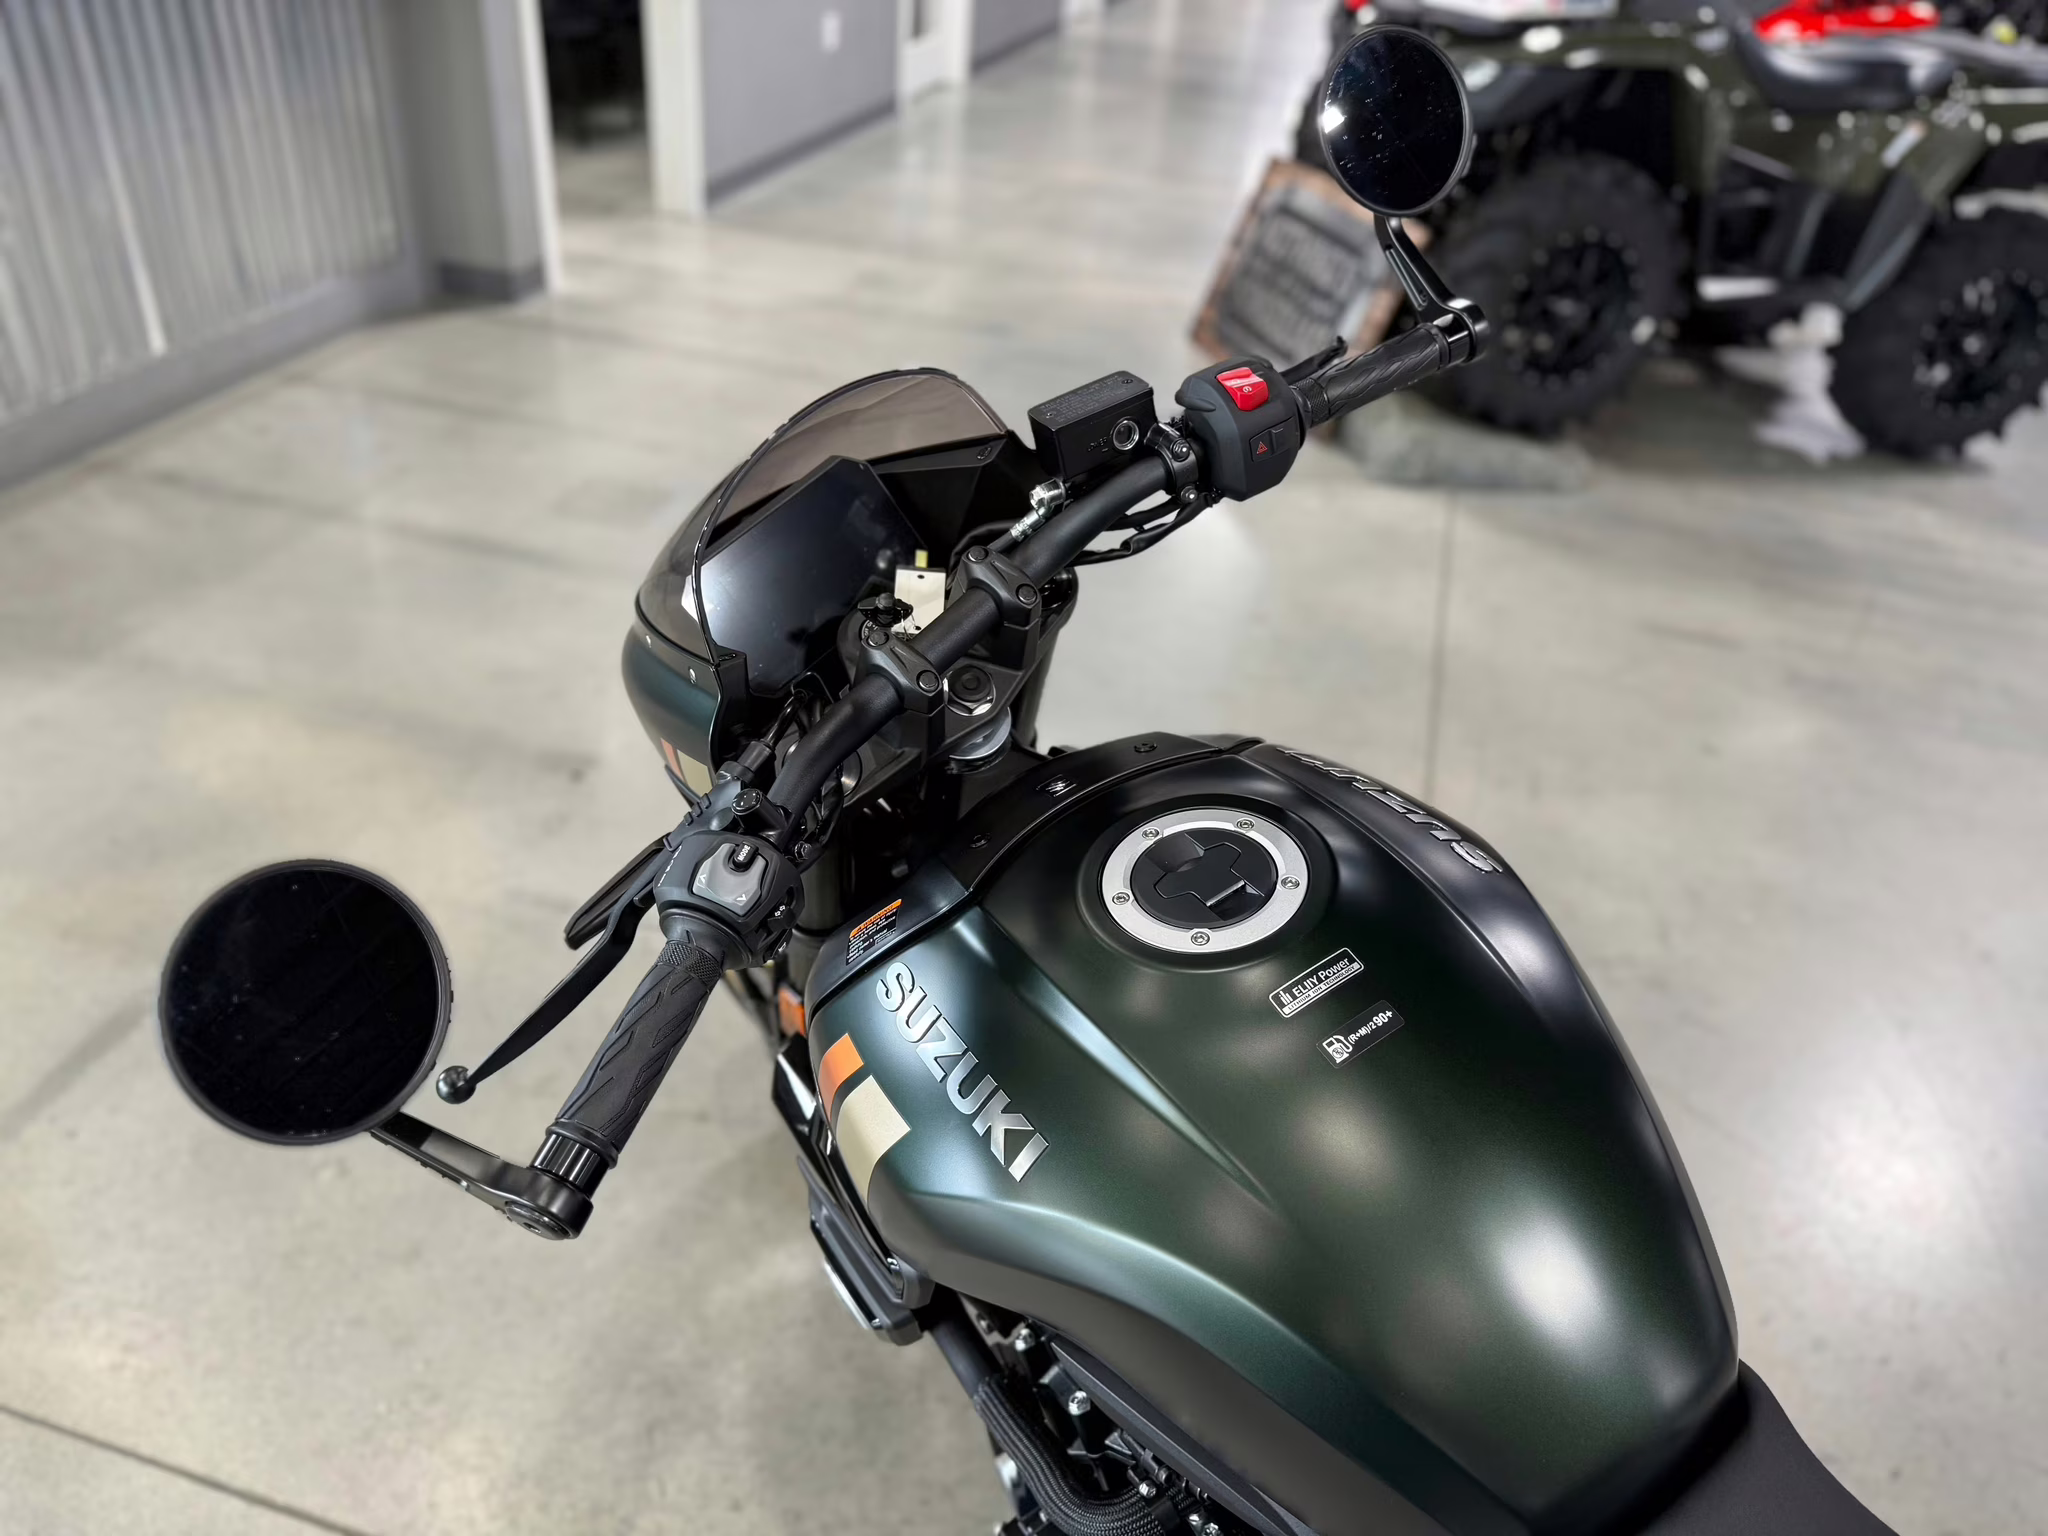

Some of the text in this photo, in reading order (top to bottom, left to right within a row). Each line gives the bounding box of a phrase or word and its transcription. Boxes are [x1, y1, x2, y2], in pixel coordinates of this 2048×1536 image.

[1276, 747, 1503, 873] SUZUKI
[737, 844, 751, 861] MODE
[1287, 965, 1356, 1011] LITHIUM ION TECHNOLOGY
[1318, 957, 1350, 981] Power
[1348, 1010, 1393, 1045] (R+M)/2 90+
[876, 961, 1049, 1183] SUZUKI
